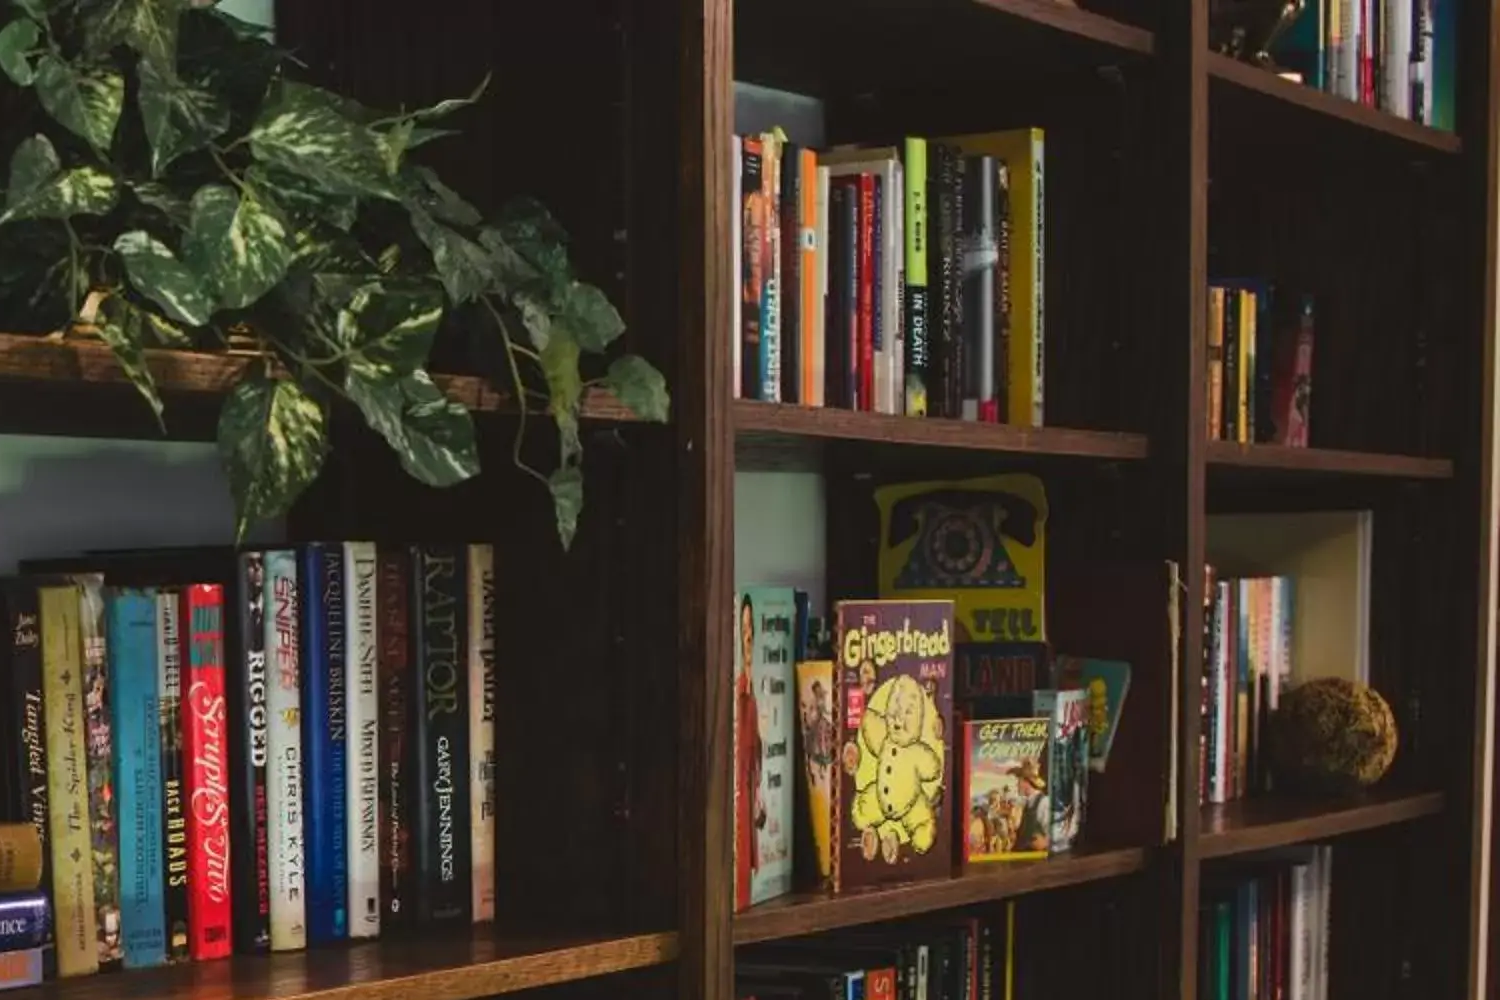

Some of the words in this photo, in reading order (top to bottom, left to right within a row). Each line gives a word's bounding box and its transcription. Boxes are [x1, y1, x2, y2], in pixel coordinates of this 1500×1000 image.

[912, 293, 925, 309] IN
[912, 315, 925, 368] DEATH
[274, 575, 293, 691] SNIPER
[324, 552, 344, 661] JACQUELINE
[424, 554, 461, 721] RAPTOR
[843, 616, 951, 668] Gingerbread
[919, 662, 947, 680] MAN
[22, 690, 46, 775] Tangled
[62, 691, 77, 736] King
[247, 649, 267, 767] RIGGED
[328, 667, 346, 741] BRISKIN
[979, 723, 1006, 741] GET
[65, 741, 82, 794] Spider
[285, 747, 298, 826] CHRIS
[434, 735, 452, 781] GARY
[166, 779, 180, 814] BACK
[167, 818, 188, 888] ROADS
[433, 780, 455, 882] JENNINGS
[205, 827, 231, 904] Two
[287, 837, 299, 903] KYLE
